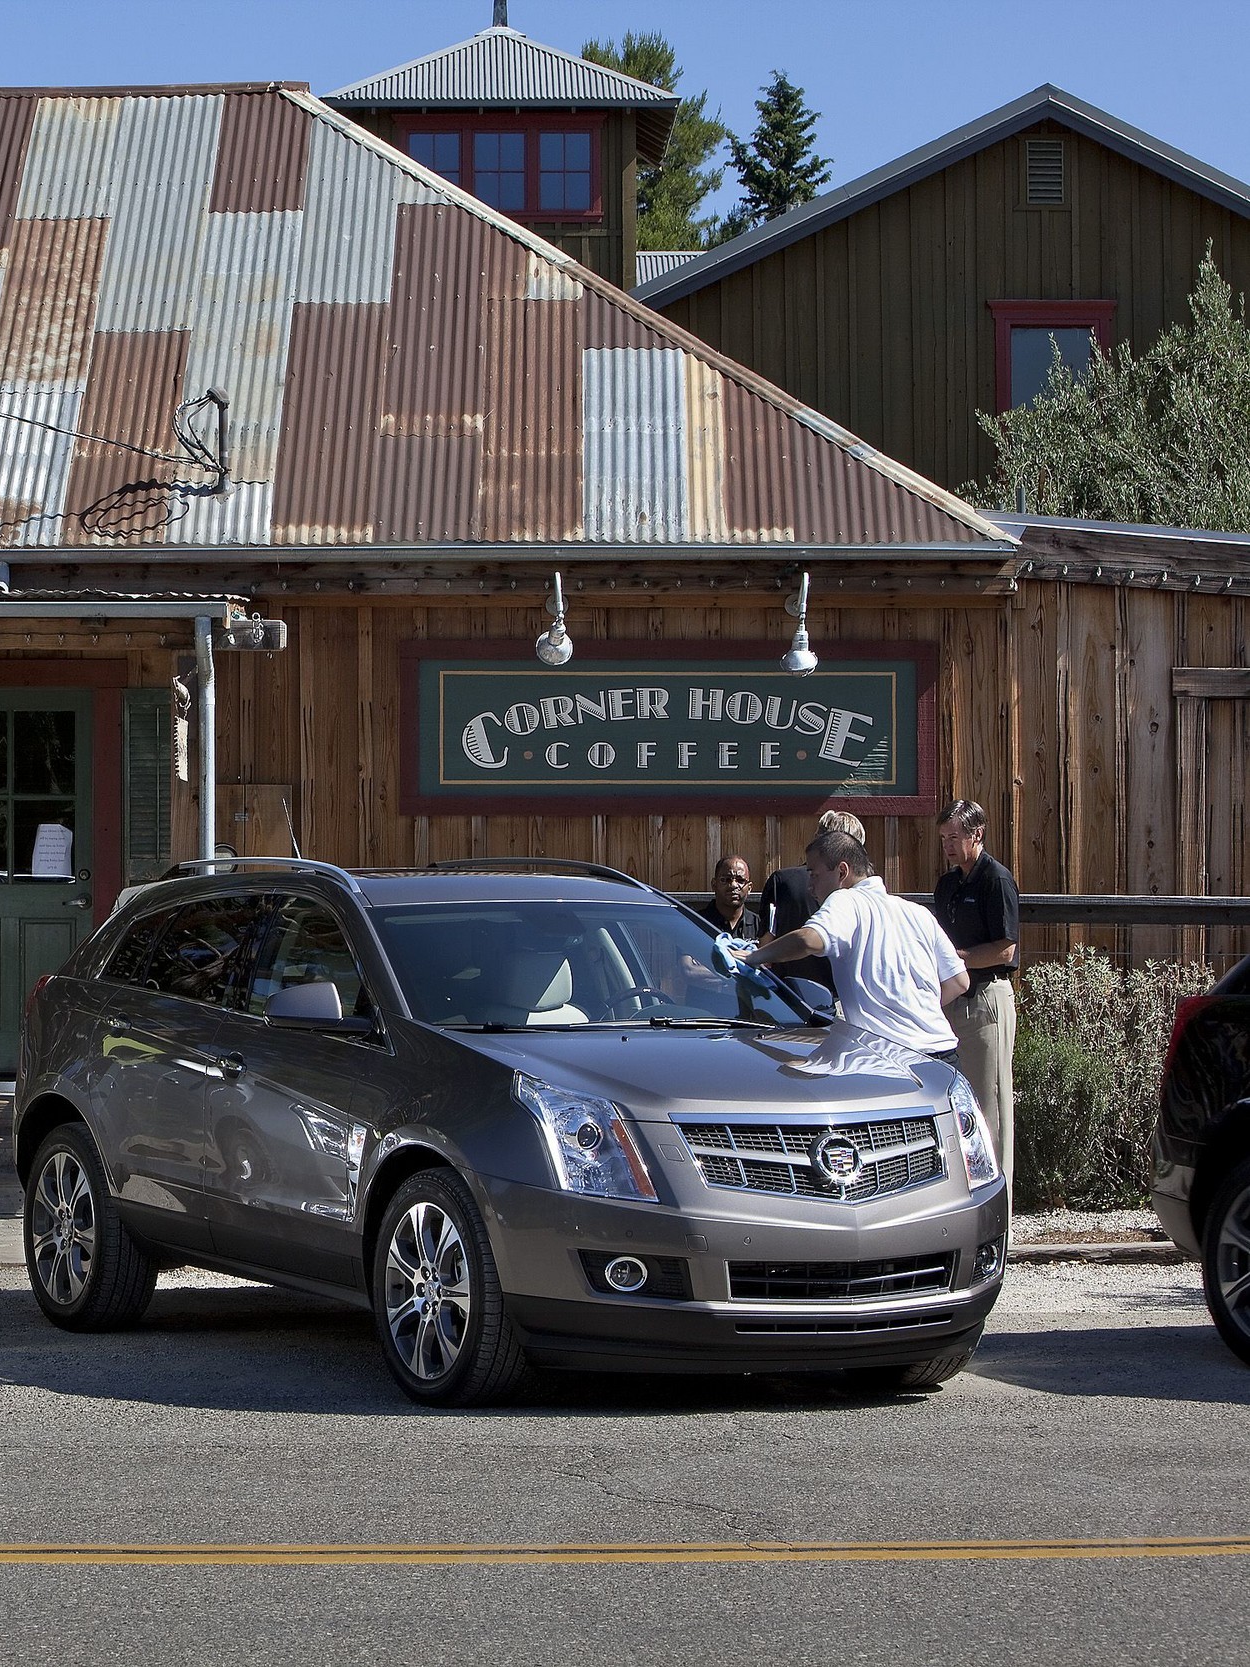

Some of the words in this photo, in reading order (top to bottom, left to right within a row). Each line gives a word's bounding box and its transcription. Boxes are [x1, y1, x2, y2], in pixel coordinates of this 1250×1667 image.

[461, 687, 670, 769] CORNER
[688, 687, 875, 767] HOUSE
[545, 742, 781, 769] COFFEE
